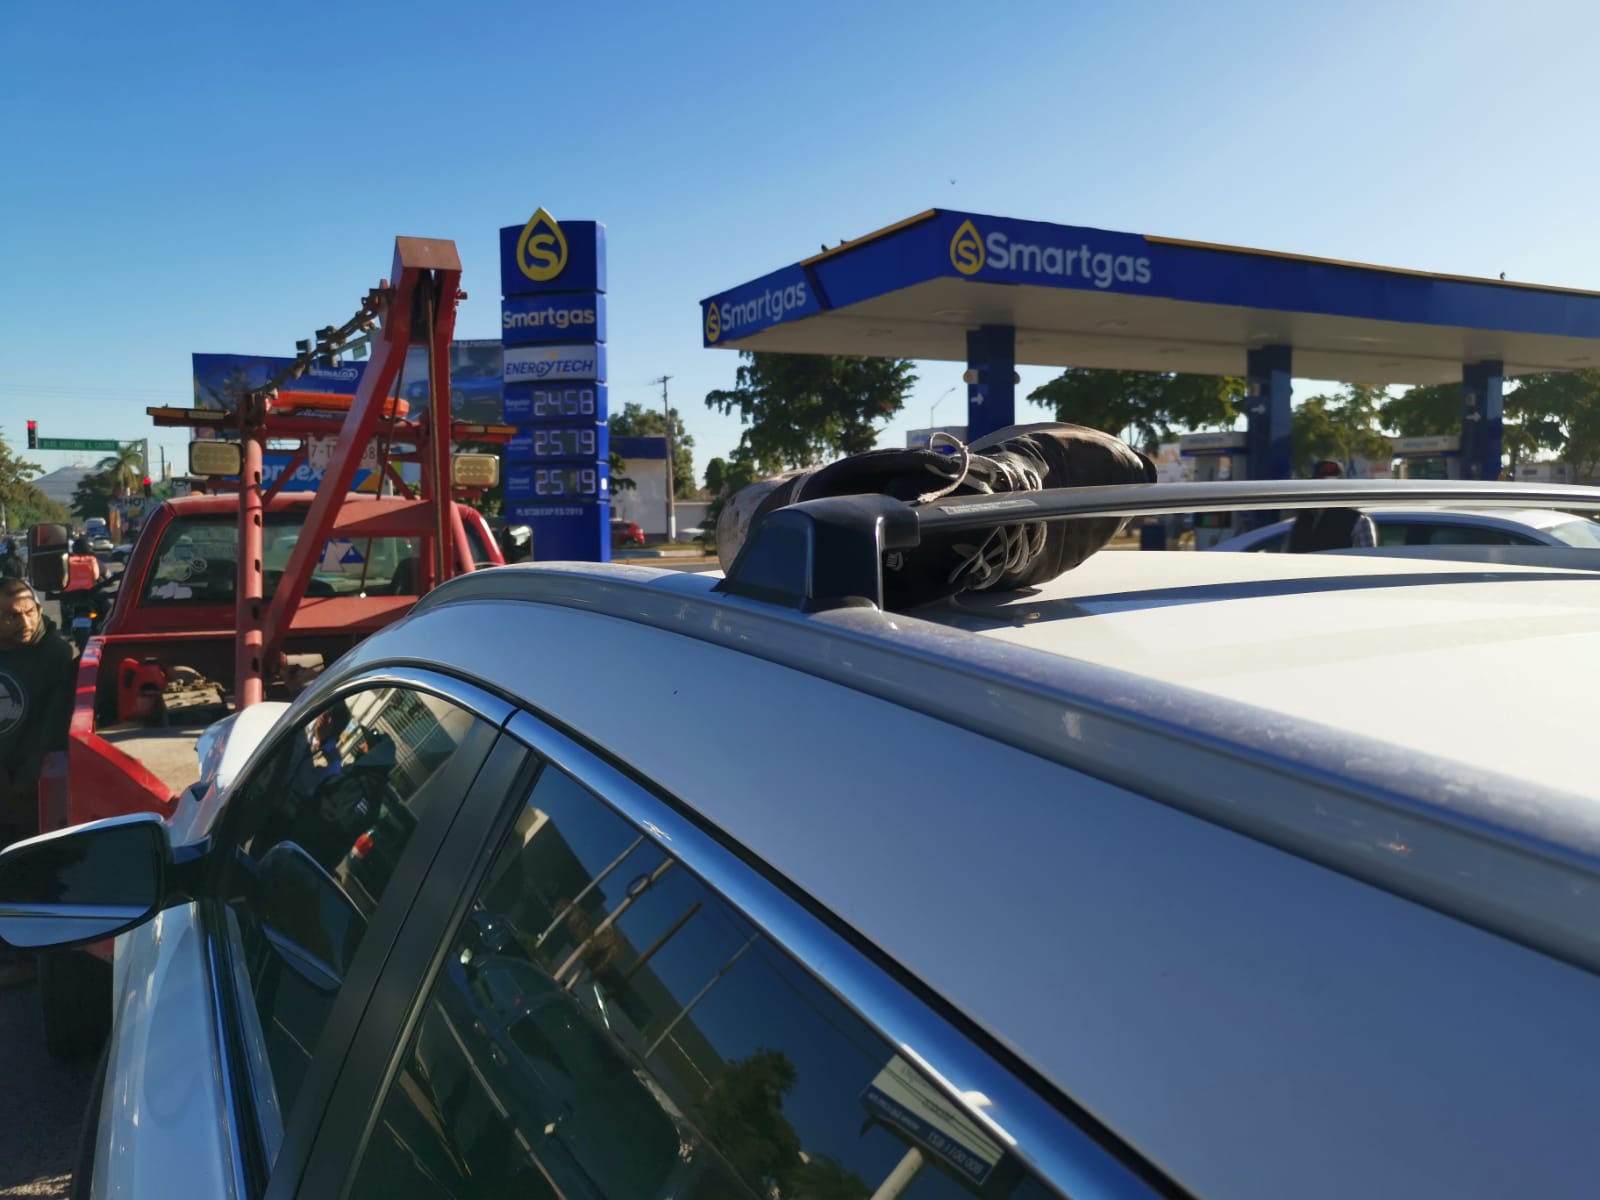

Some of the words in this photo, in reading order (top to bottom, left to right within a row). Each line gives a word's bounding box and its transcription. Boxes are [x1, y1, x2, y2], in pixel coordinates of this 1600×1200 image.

[986, 232, 1152, 289] Smartgas
[503, 307, 595, 329] Smartgas
[721, 279, 807, 331] Smartgas
[505, 359, 594, 378] ENERGYTECH
